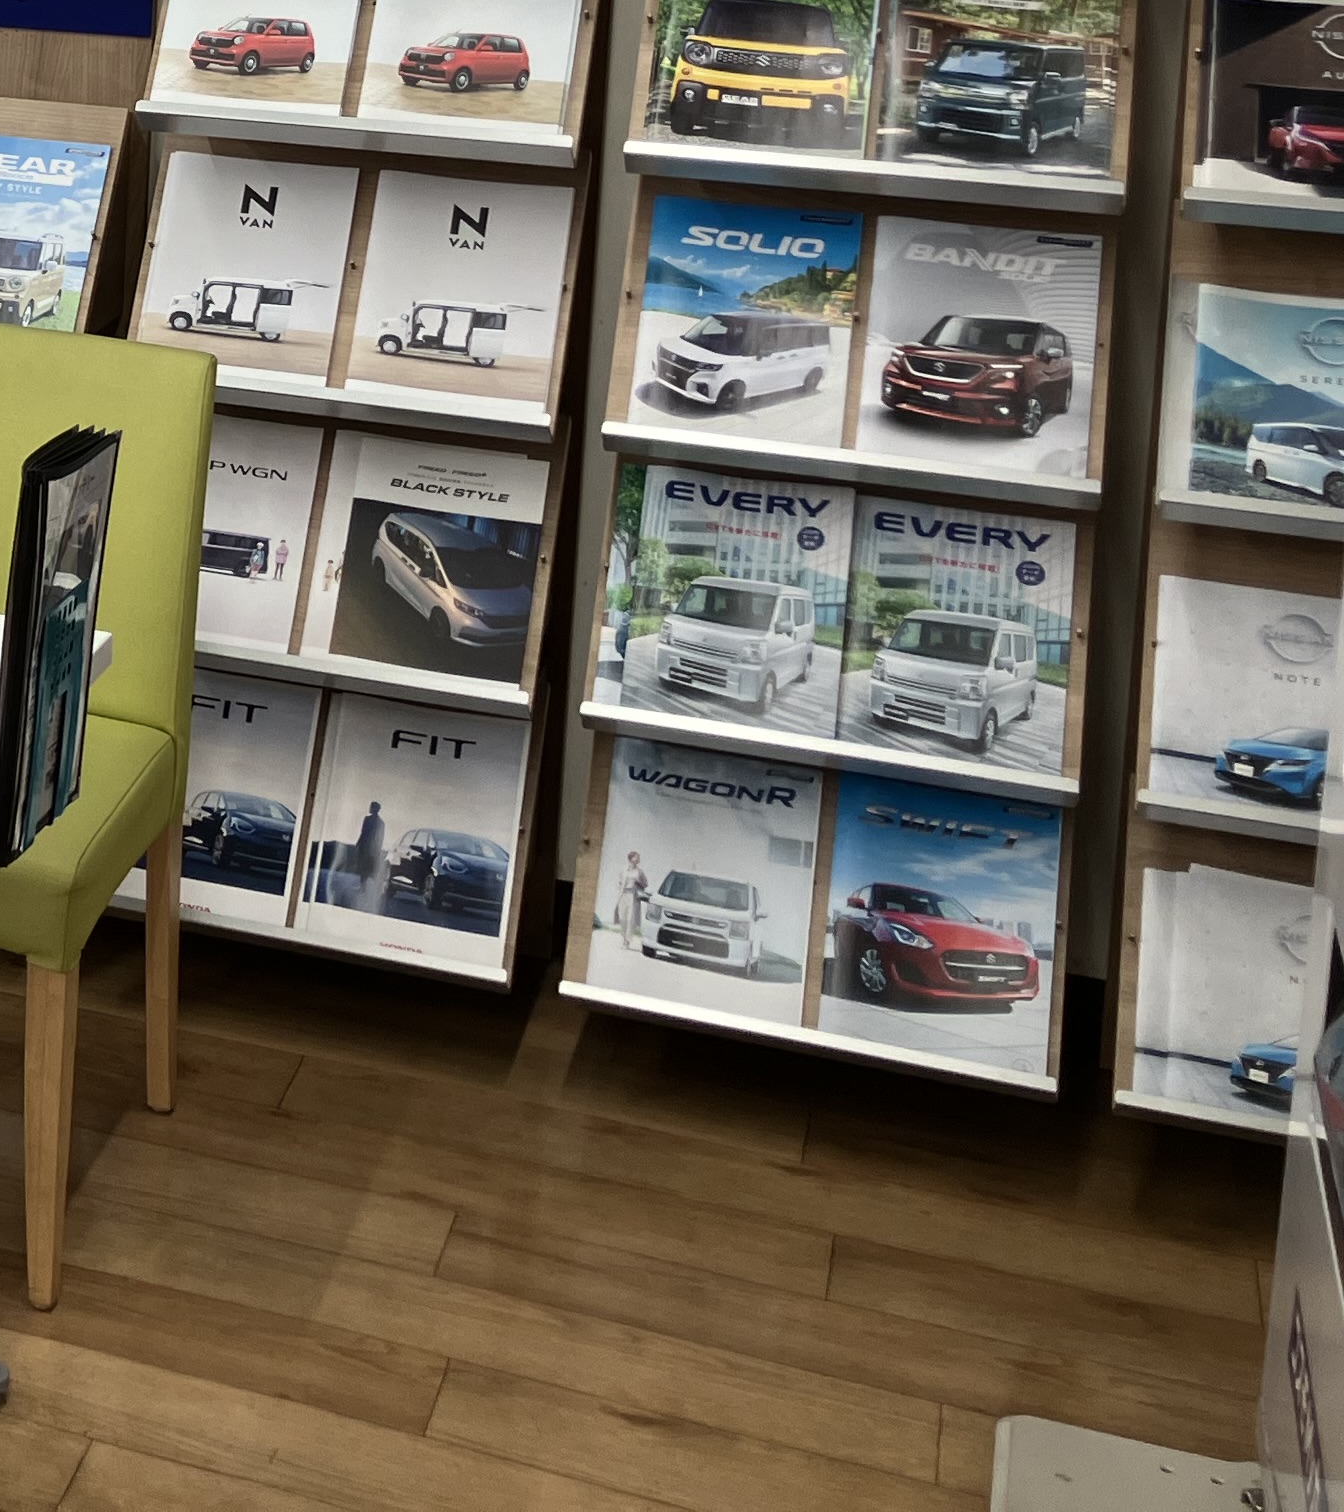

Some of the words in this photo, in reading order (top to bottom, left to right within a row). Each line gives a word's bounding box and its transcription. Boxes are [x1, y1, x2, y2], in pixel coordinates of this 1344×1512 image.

[6, 182, 42, 196] STYLE
[240, 184, 279, 216] N
[239, 217, 274, 229] VAN
[450, 204, 489, 238] N
[448, 238, 485, 251] VAN
[682, 225, 825, 258] SOLIO
[905, 243, 1068, 276] BANDIT
[390, 477, 451, 495] BLACK
[453, 488, 510, 503] STYLE
[665, 479, 830, 518] EVERY
[873, 512, 1052, 552] EVERY
[1273, 672, 1322, 687] NOTE
[390, 730, 477, 759] FIT
[858, 805, 1036, 848] SWIFT
